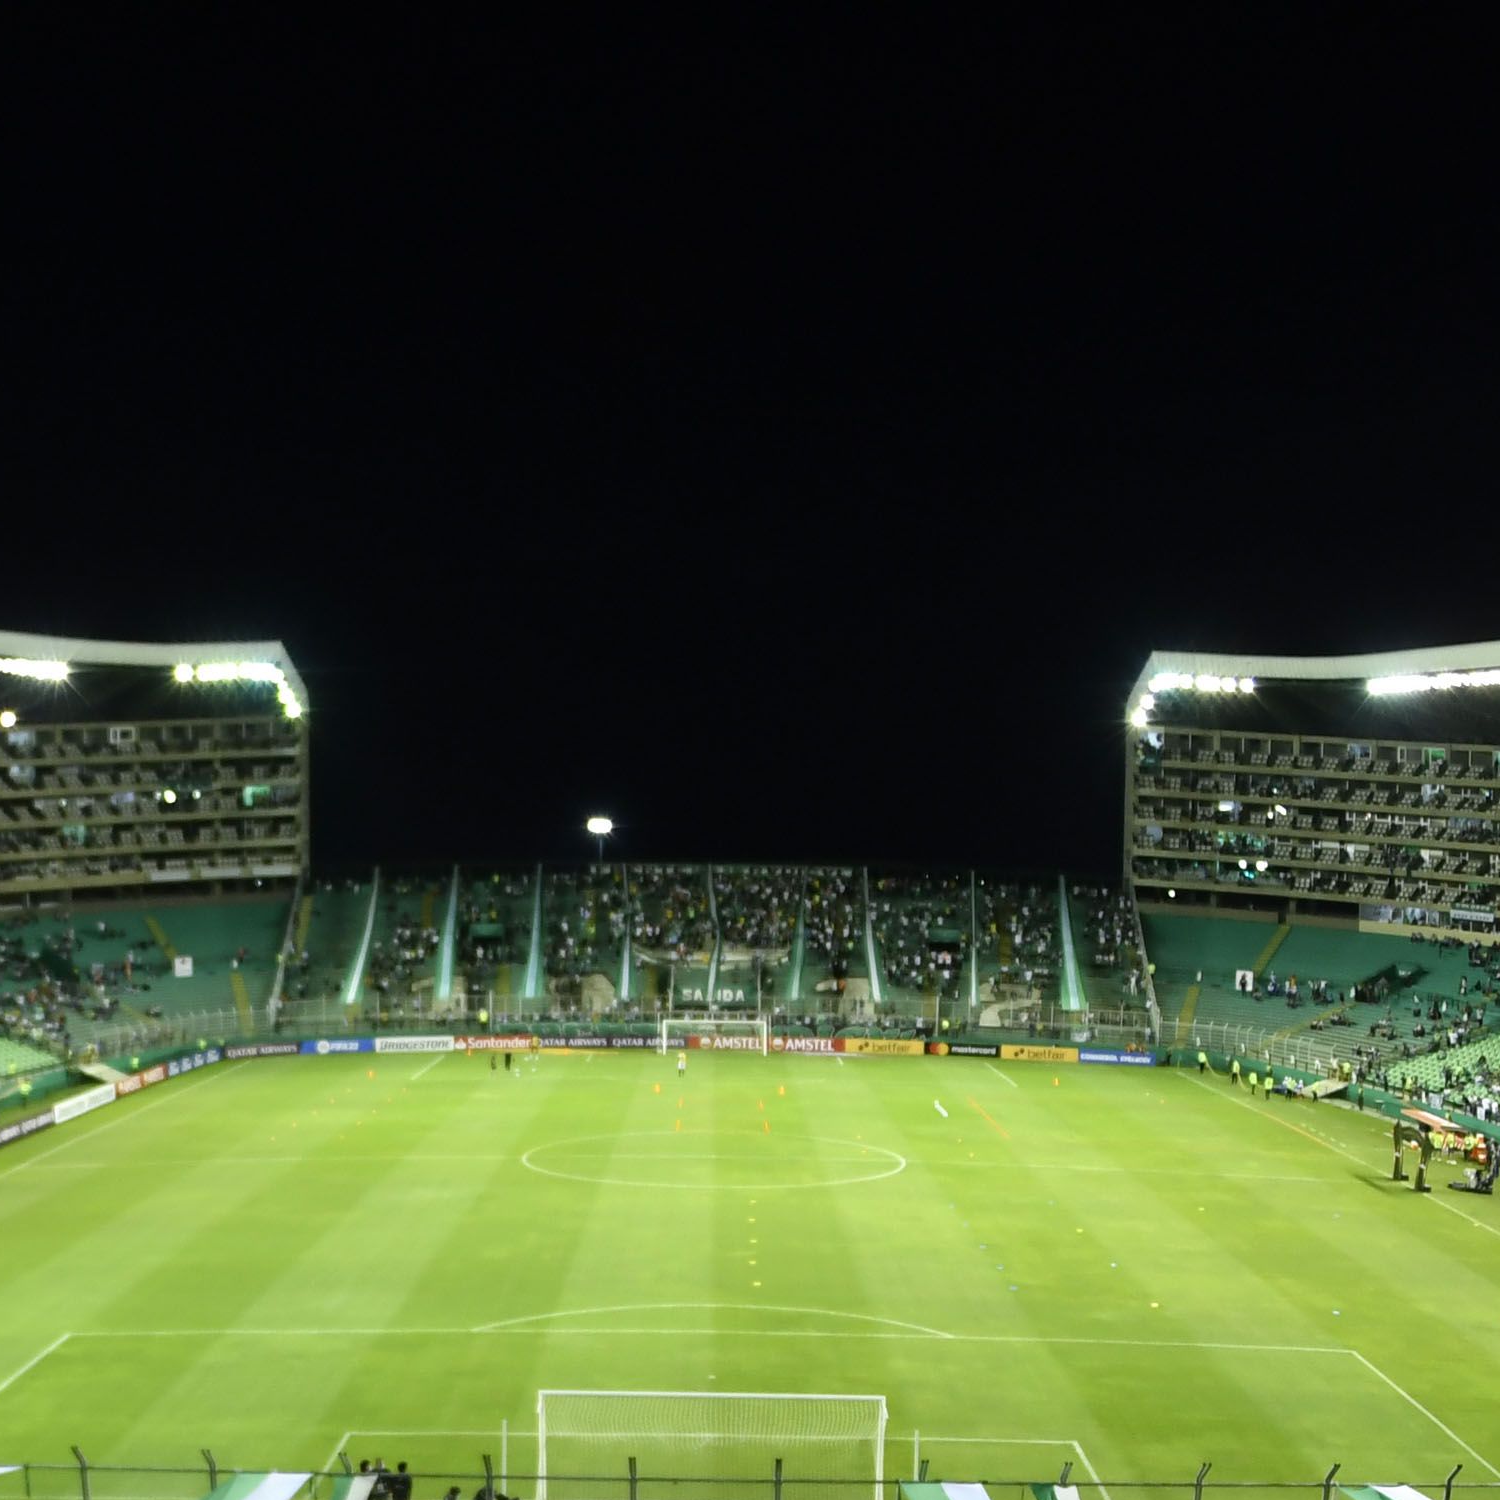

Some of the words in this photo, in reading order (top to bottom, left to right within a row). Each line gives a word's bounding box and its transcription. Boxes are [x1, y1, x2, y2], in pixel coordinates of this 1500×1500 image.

[379, 1039, 451, 1050] BRIDGESTONE
[467, 1036, 531, 1049] Santander
[537, 1038, 566, 1049] QATAR
[568, 1036, 607, 1047] AIRWAYS
[612, 1037, 644, 1048] QATAR
[713, 1037, 762, 1050] AMSTEL
[785, 1038, 835, 1051] AMSTEL
[871, 1041, 911, 1053] betfair
[951, 1045, 997, 1056] mastercard
[1027, 1048, 1067, 1061] betfair
